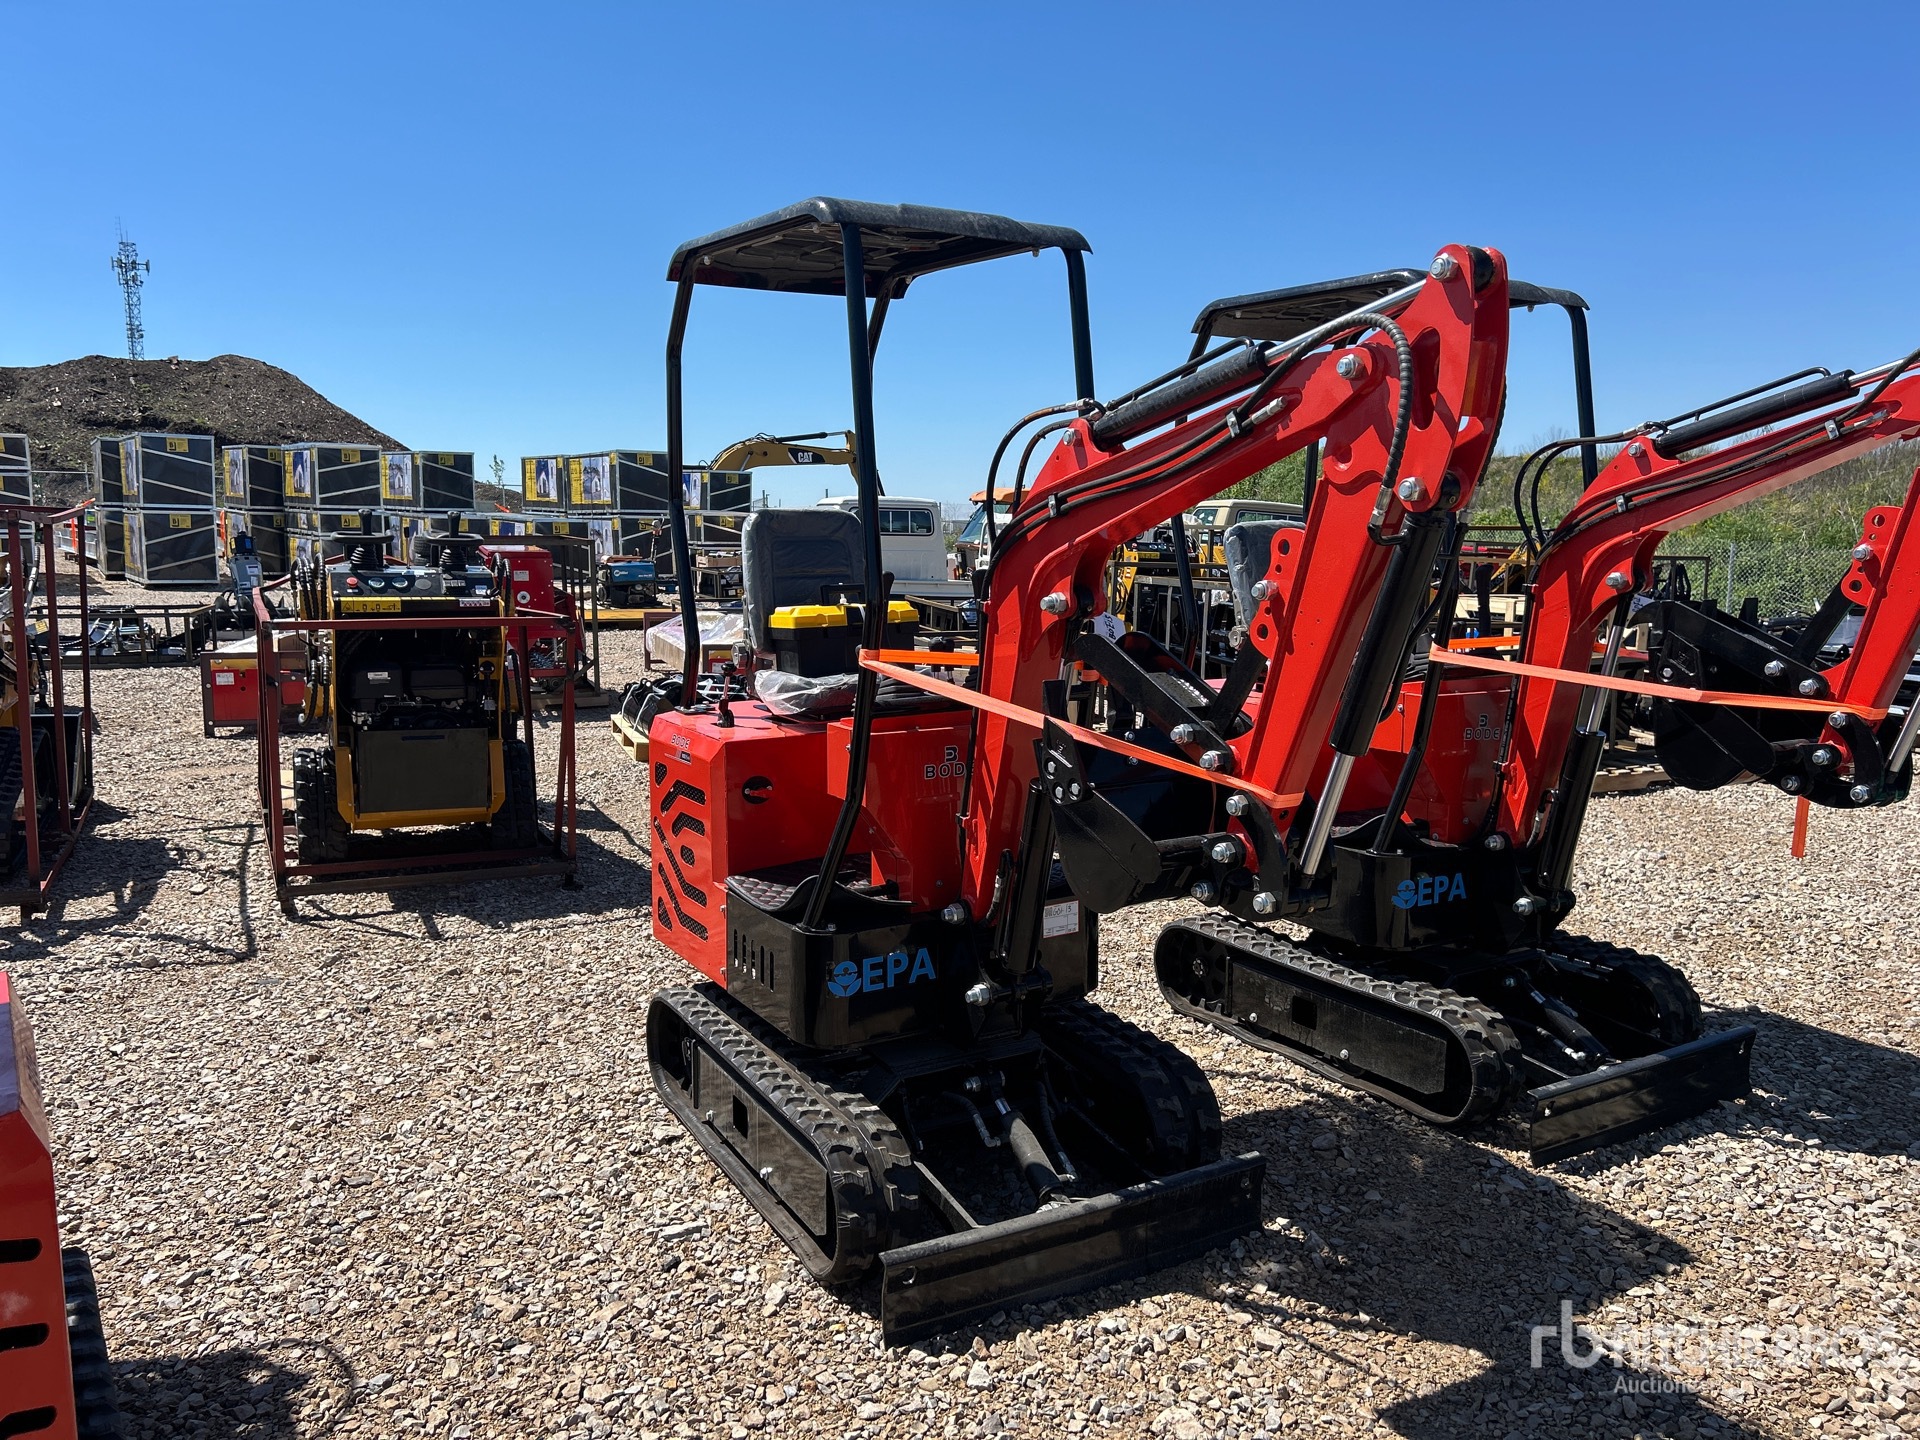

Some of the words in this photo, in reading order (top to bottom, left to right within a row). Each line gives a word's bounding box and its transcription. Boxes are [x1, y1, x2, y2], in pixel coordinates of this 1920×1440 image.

[797, 451, 814, 463] CAT
[671, 733, 691, 750] BODE
[1464, 728, 1501, 741] BODE
[924, 761, 967, 780] BOD
[1417, 872, 1467, 907] EPA
[862, 947, 937, 993] EPA
